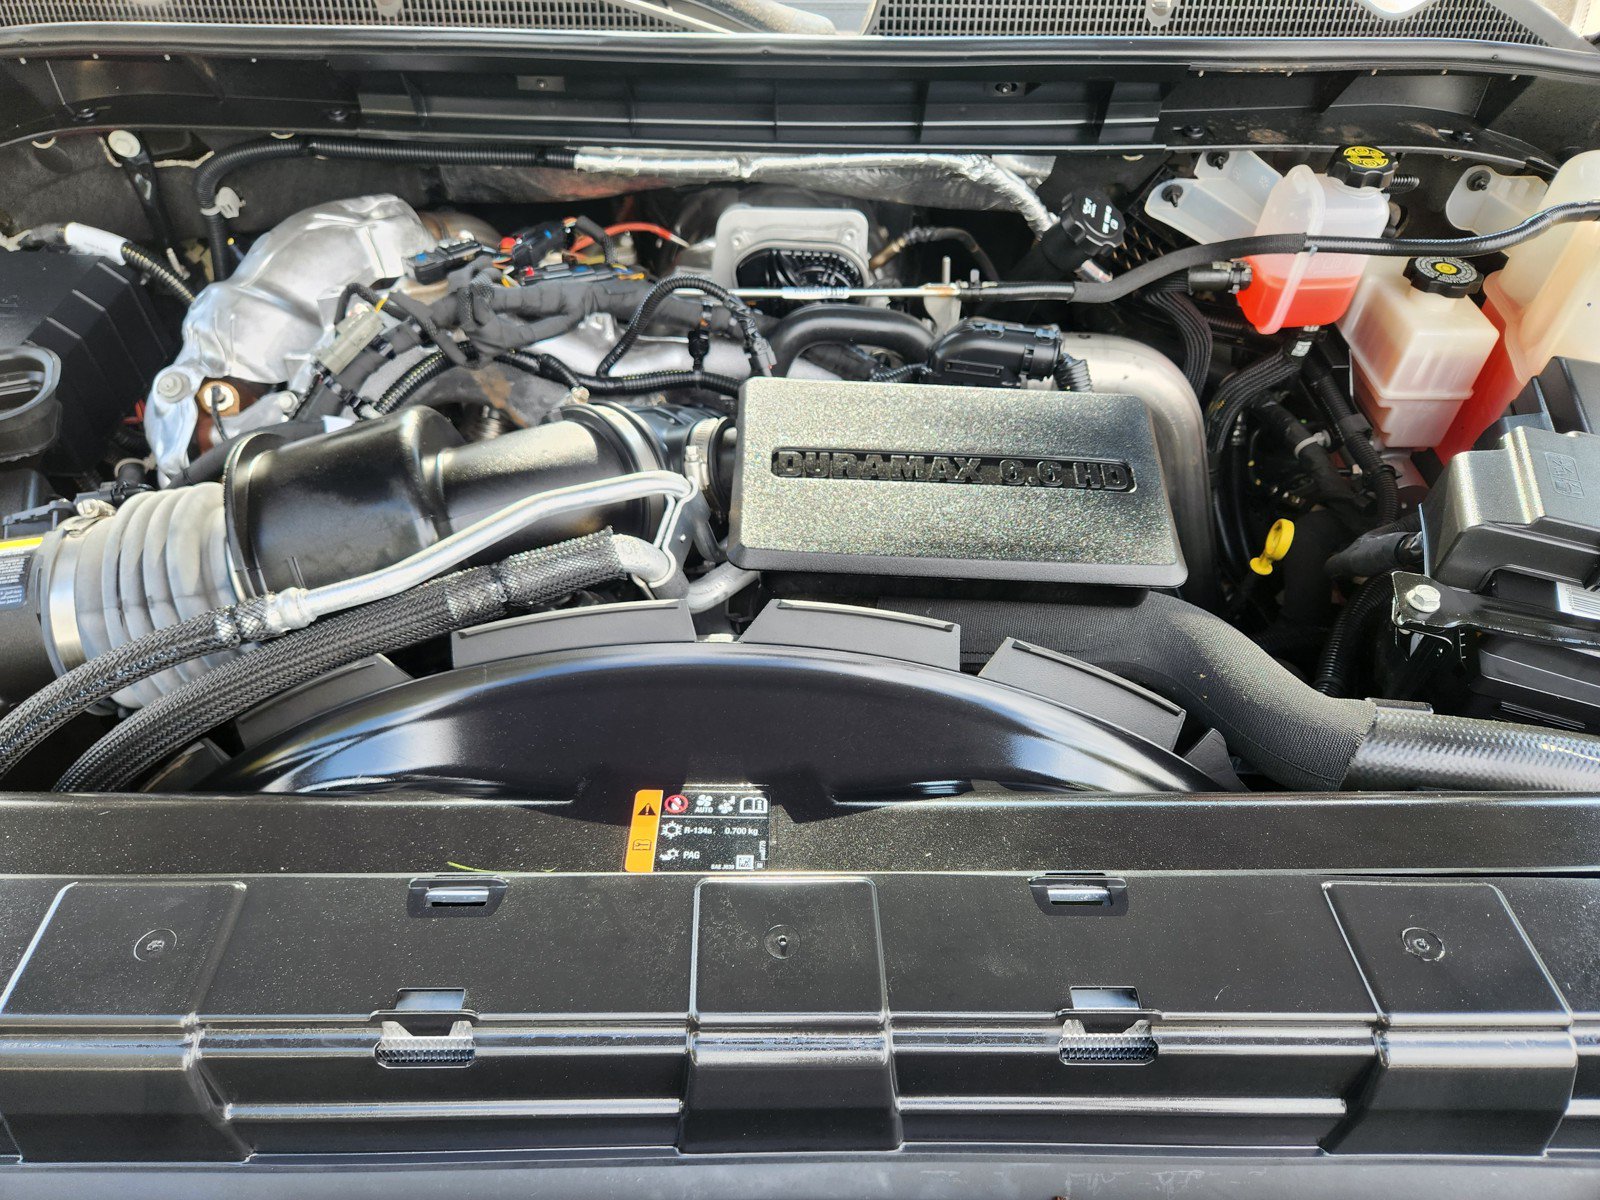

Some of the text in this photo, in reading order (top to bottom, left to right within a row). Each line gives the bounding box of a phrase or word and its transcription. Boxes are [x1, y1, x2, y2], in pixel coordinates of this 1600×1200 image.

[776, 450, 1128, 491] DURAMAX 6.6 HD
[748, 828, 758, 836] kg
[683, 851, 700, 860] PAG
